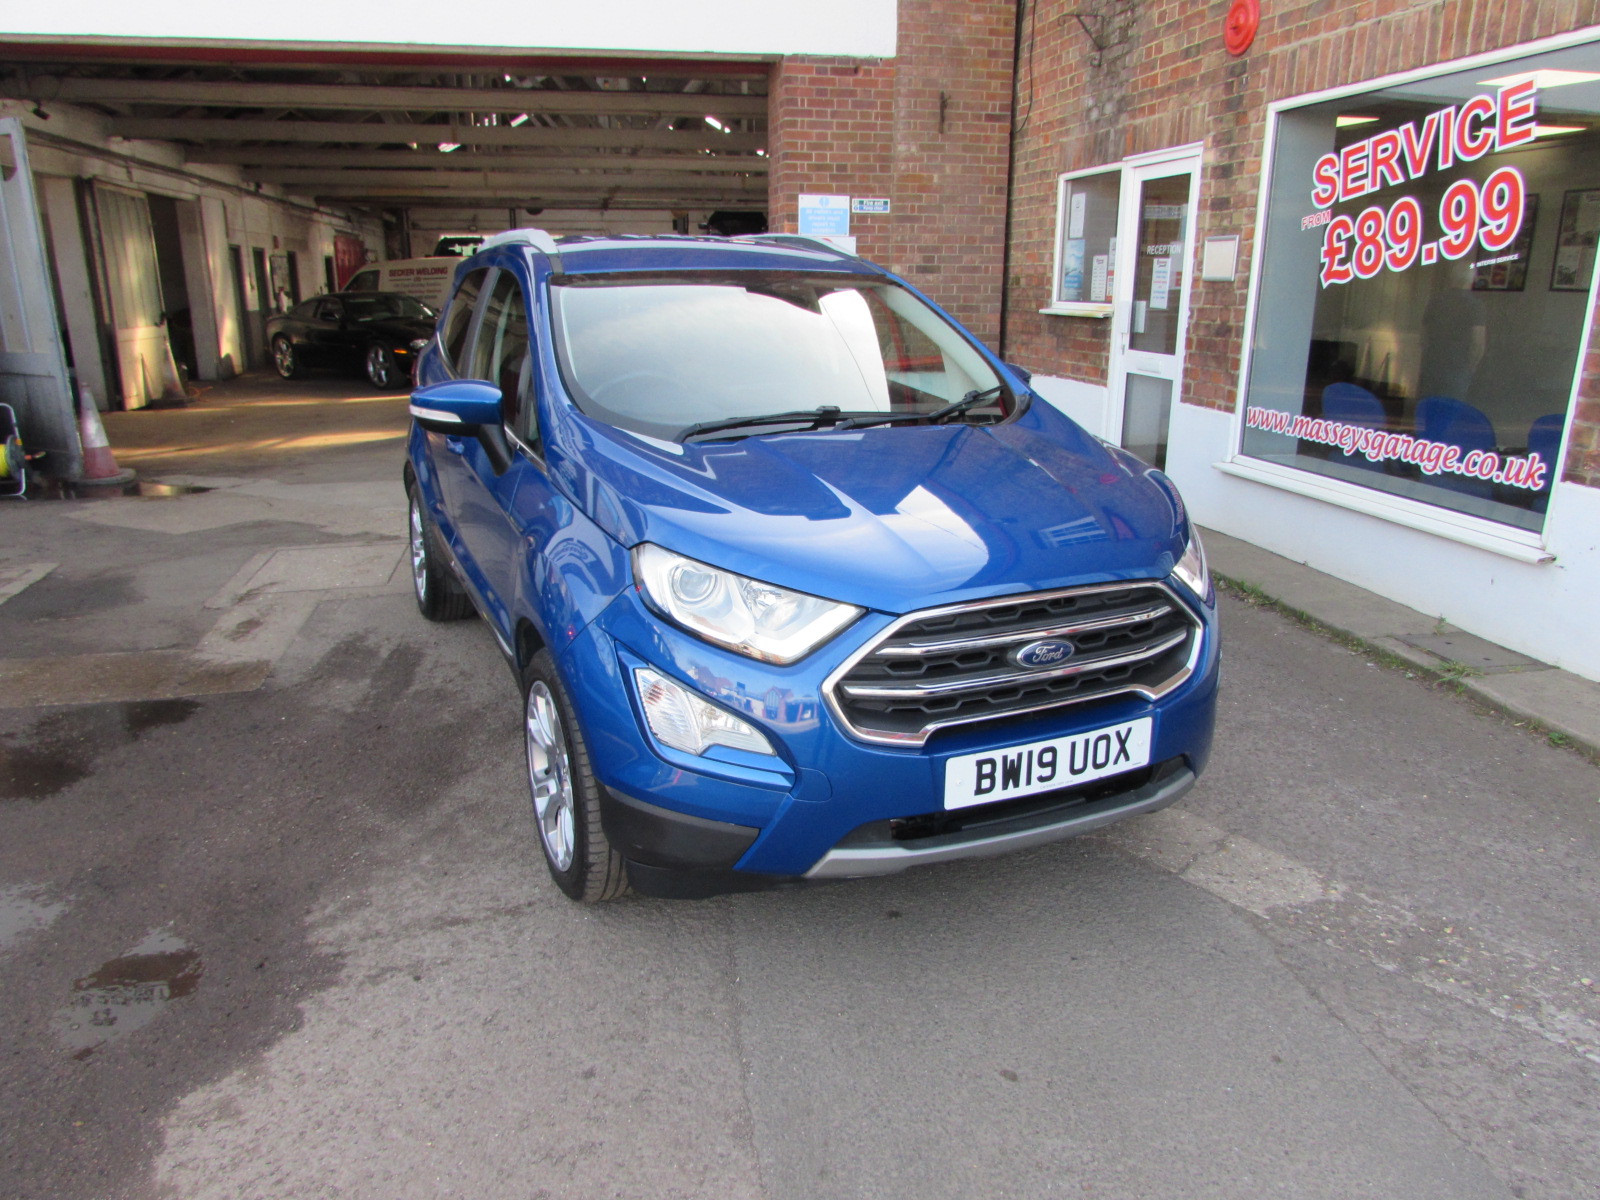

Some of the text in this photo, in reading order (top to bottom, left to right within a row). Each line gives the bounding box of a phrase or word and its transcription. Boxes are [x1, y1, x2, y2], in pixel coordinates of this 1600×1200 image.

[1311, 77, 1538, 209] SERVICE
[1301, 208, 1332, 231] FROM
[1320, 166, 1526, 289] £89.99
[1146, 244, 1182, 255] RECEPTION
[1496, 253, 1519, 263] SERVICE
[416, 267, 448, 275] WELDING
[1246, 405, 1546, 491] www.masseysgarage.co.uk
[1032, 645, 1064, 663] Ford
[974, 727, 1132, 797] BW19 UOX
